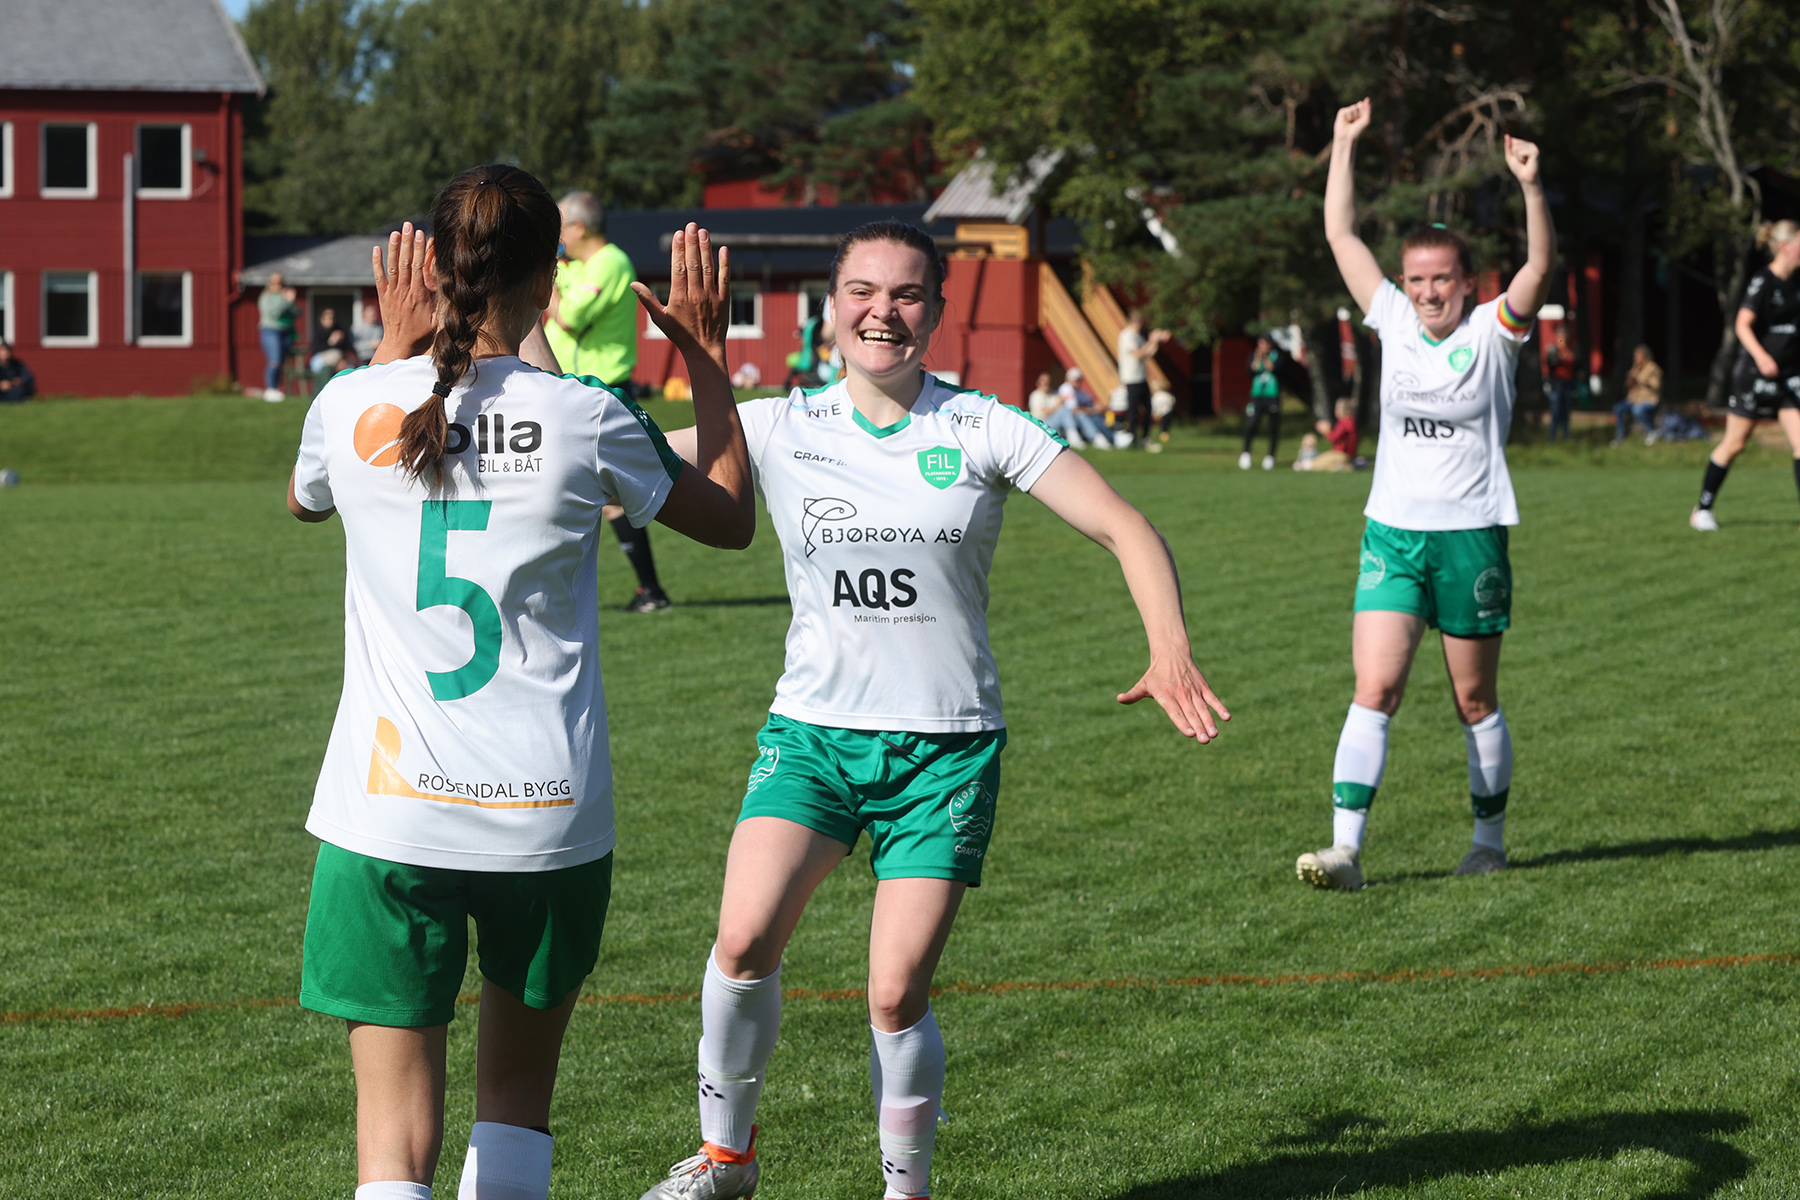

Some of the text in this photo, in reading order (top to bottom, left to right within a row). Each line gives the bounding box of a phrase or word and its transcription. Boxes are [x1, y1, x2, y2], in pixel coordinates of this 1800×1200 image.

[808, 403, 842, 419] NTE
[951, 412, 983, 429] NTE
[1403, 416, 1456, 440] AQS
[478, 454, 543, 473] BIL & BÅT
[793, 450, 837, 464] CRAFT
[926, 453, 955, 469] FIL
[822, 527, 962, 544] BJØRØYA AS
[832, 568, 918, 611] AQS
[416, 500, 503, 701] 5
[854, 613, 937, 625] Maritim presisjon
[418, 773, 571, 799] ROSENDAL BYGG
